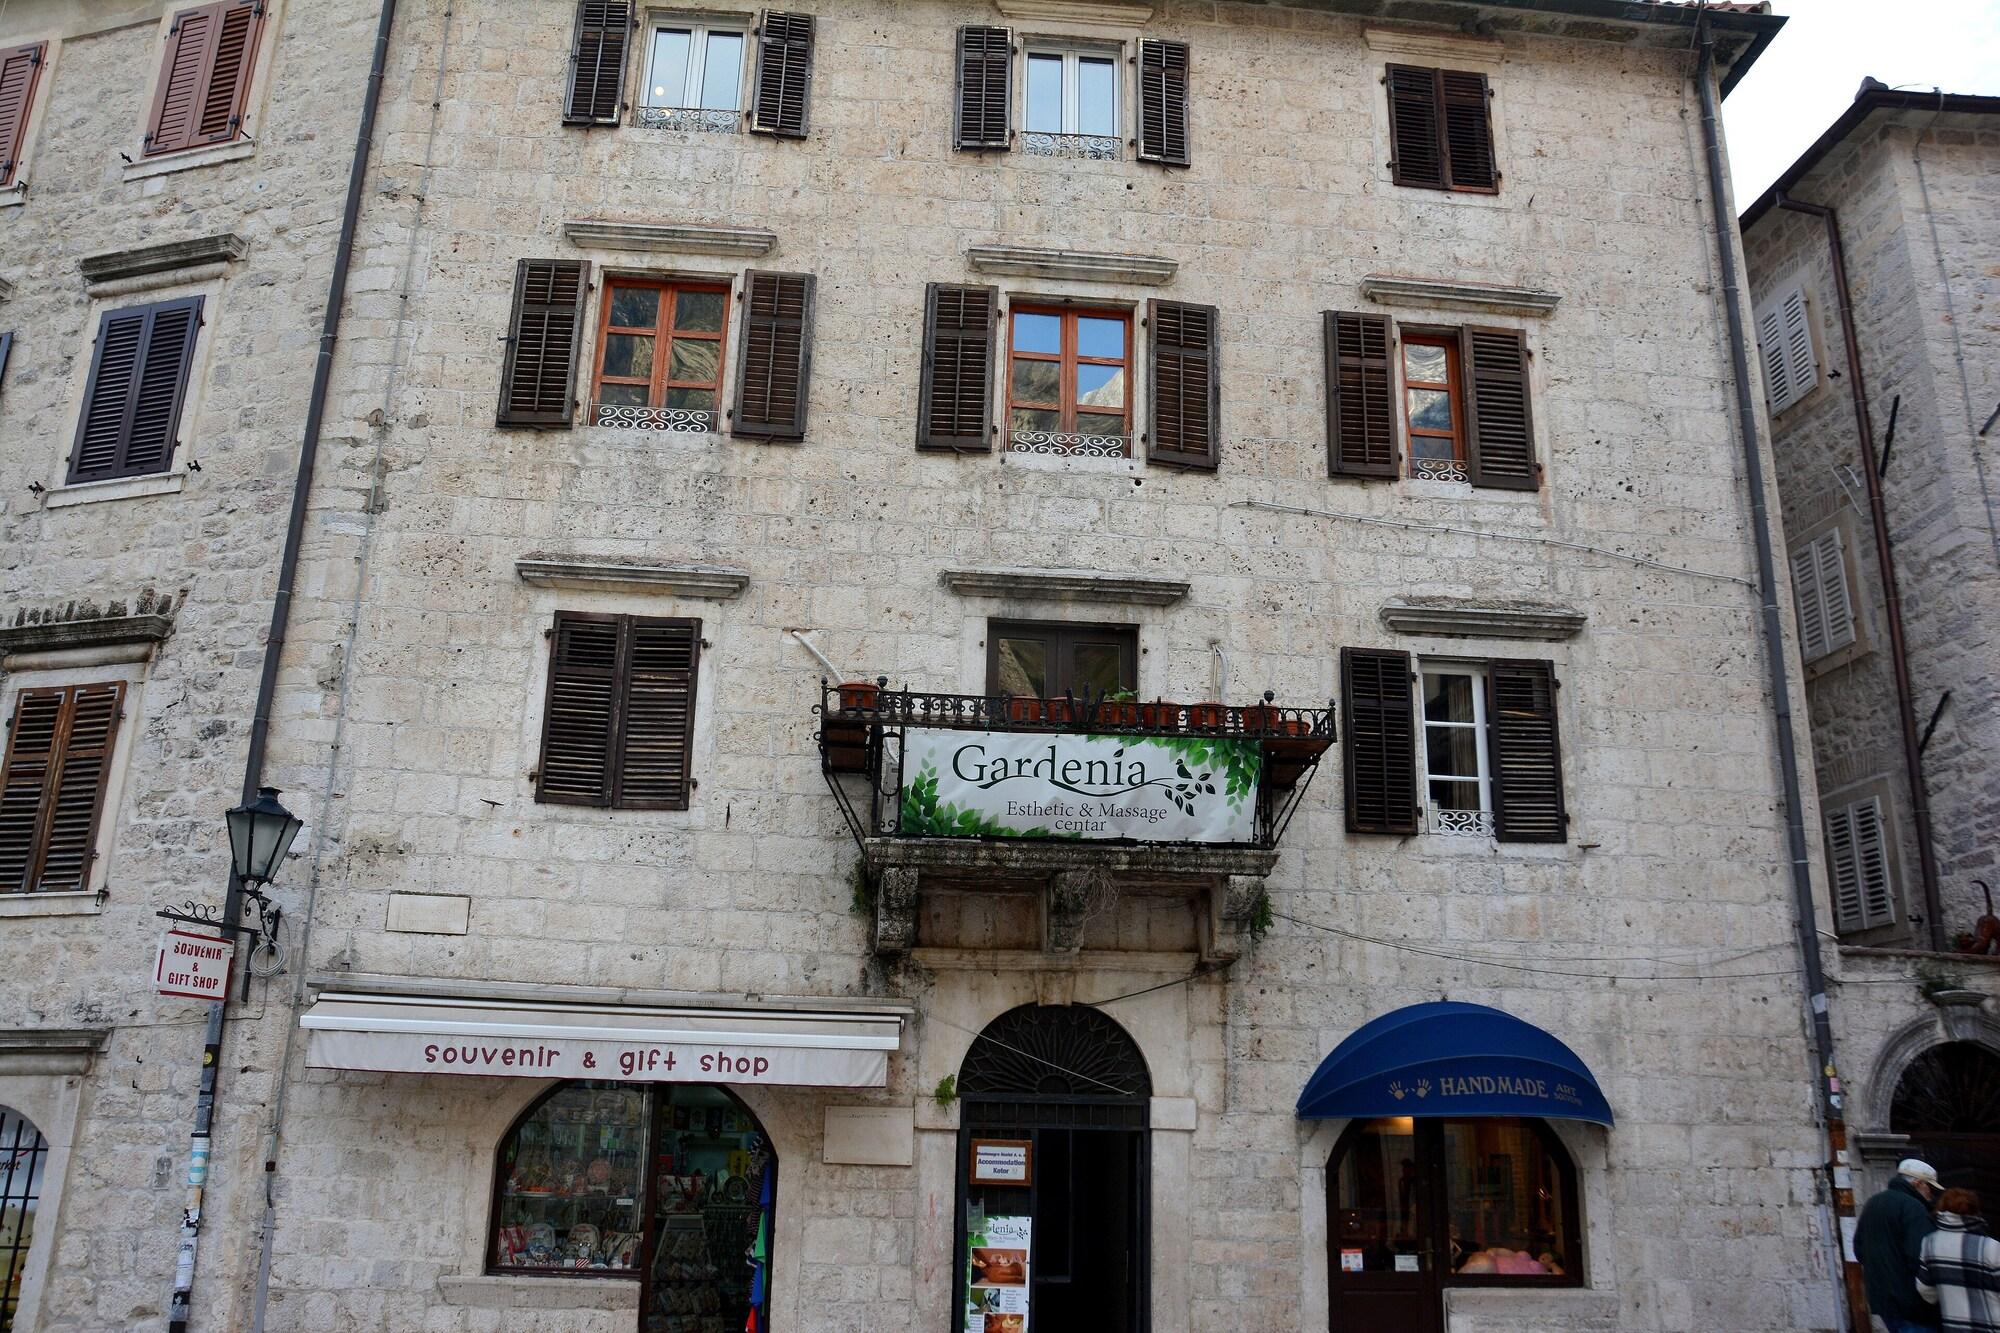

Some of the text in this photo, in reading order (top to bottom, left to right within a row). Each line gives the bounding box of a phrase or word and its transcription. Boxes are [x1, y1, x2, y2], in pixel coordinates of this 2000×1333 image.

[952, 744, 1148, 791] Gardenia
[1006, 800, 1168, 824] Esthetic & Massage
[1055, 818, 1107, 832] centar
[174, 941, 222, 960] SOUVENIR
[192, 962, 199, 972] &
[168, 972, 219, 990] GIFT SHOP
[424, 1044, 769, 1077] souvenir & gift shop
[1440, 1076, 1548, 1098] HANDMADE
